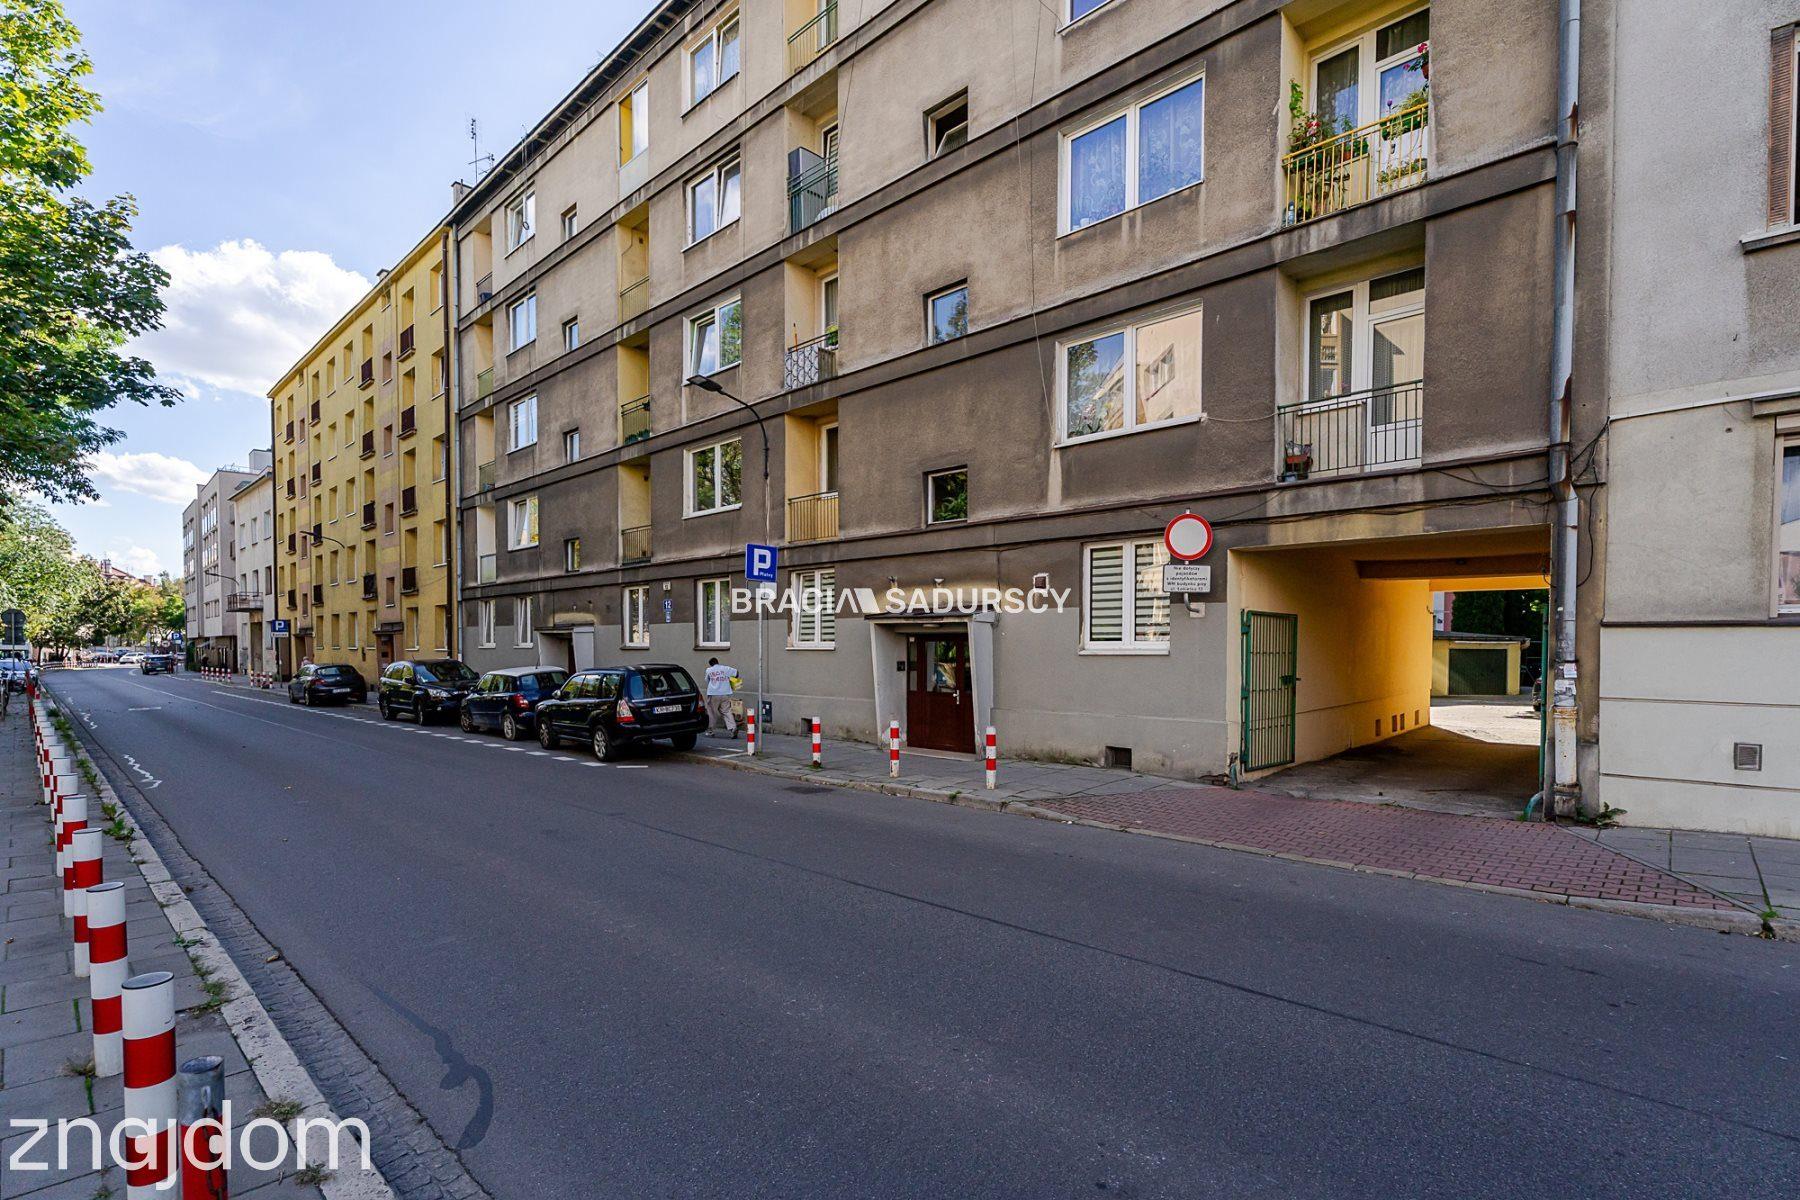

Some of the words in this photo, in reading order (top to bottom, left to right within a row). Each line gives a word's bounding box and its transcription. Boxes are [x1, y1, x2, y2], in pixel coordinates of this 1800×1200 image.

[753, 548, 771, 576] P
[664, 600, 672, 609] 12
[275, 620, 285, 631] P
